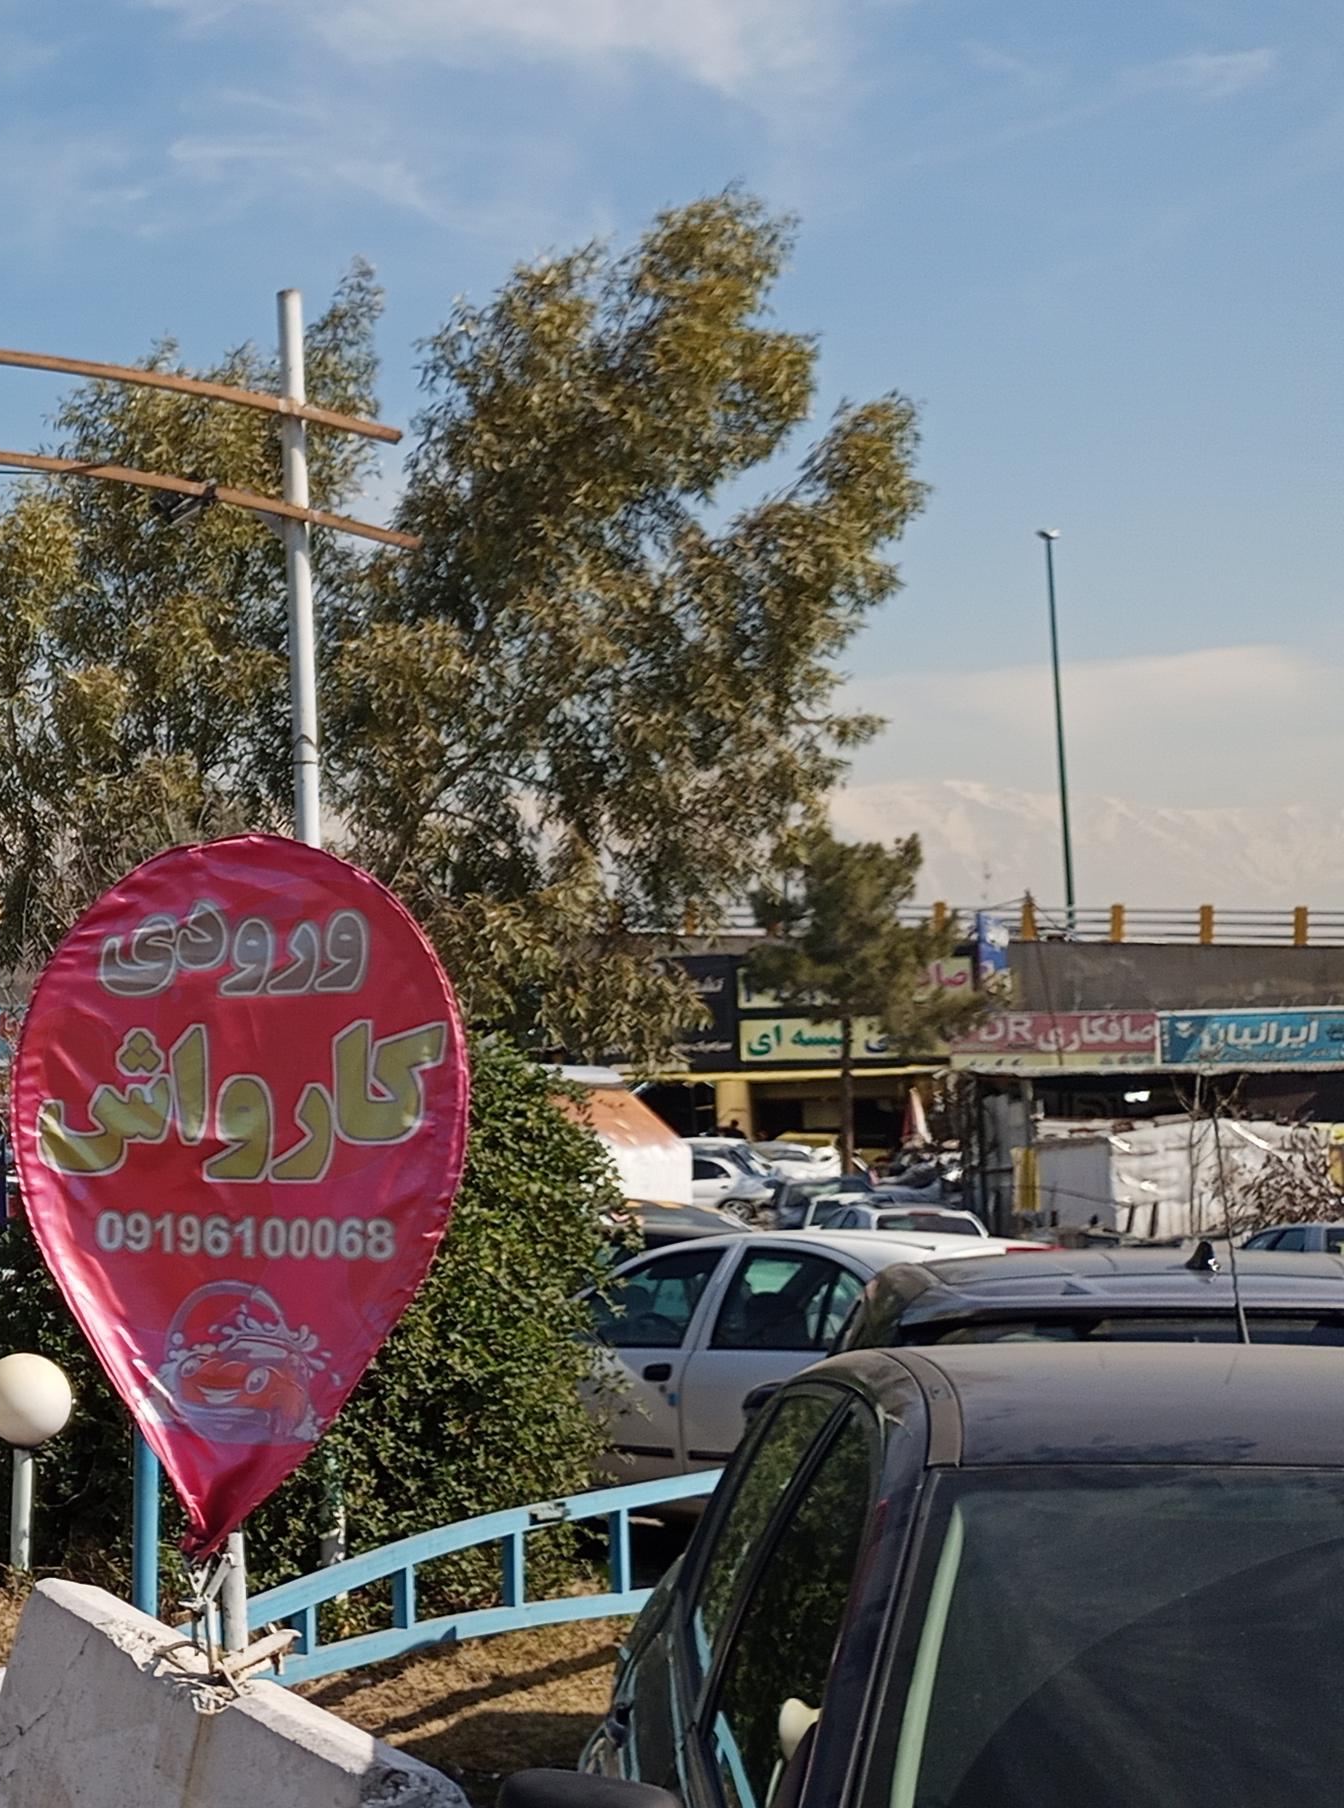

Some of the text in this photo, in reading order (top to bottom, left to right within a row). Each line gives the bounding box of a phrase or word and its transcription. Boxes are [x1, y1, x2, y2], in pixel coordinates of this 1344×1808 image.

[98, 900, 370, 996] ورودی
[1037, 1015, 1155, 1052] صافکاری
[1201, 1019, 1319, 1052] ایرانیان
[37, 1019, 448, 1183] کارواش
[96, 1211, 396, 1261] 09196100068
